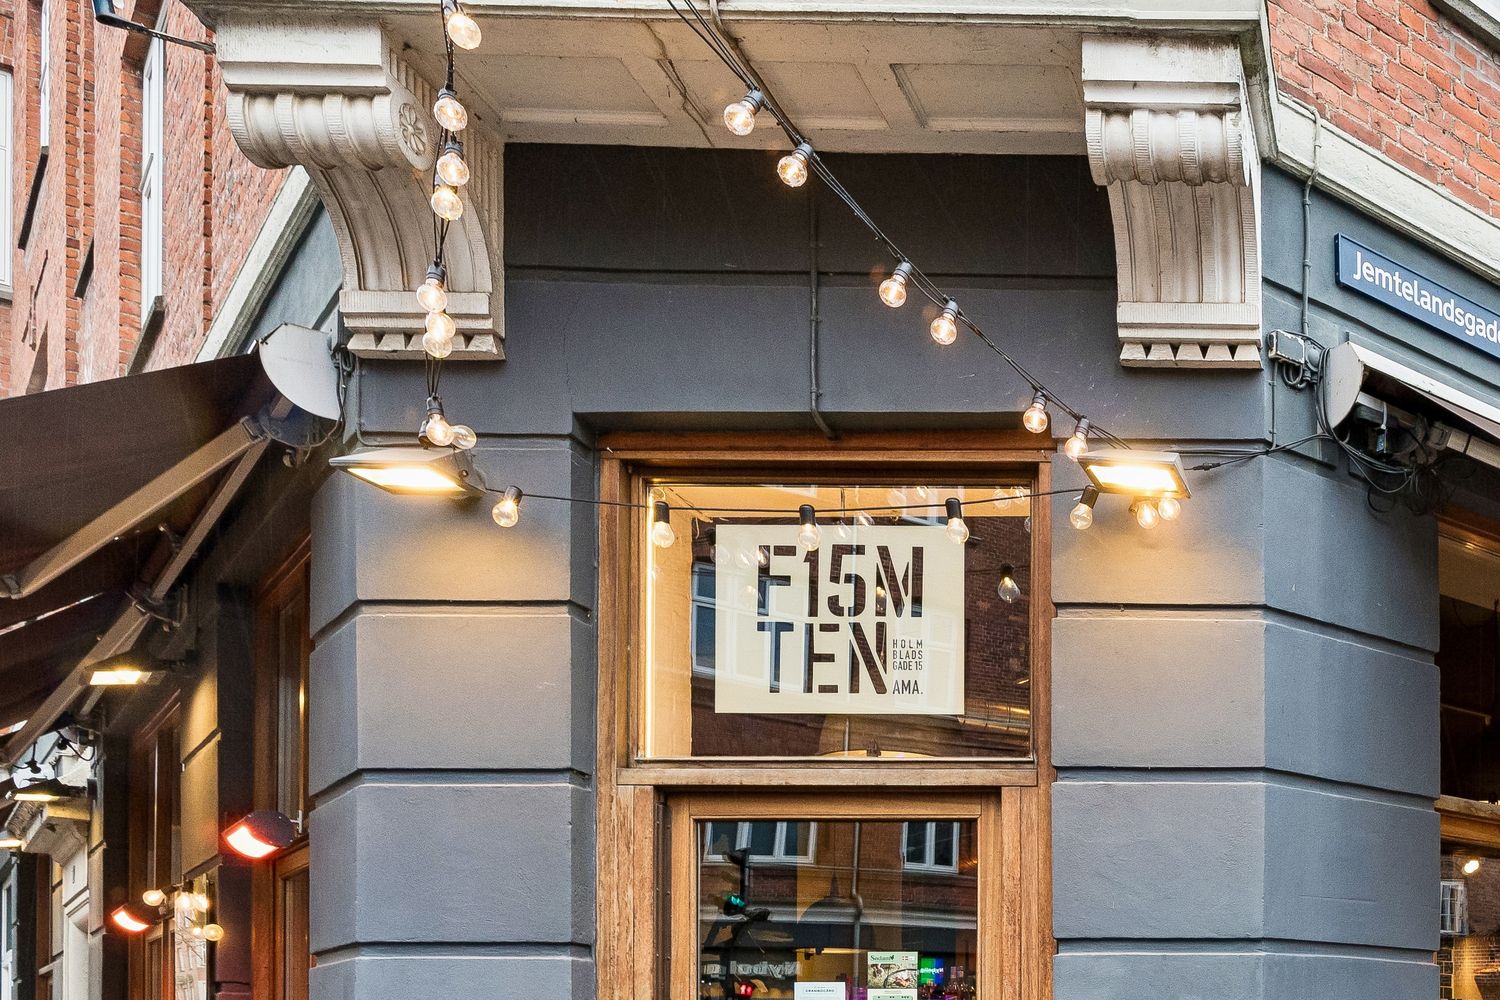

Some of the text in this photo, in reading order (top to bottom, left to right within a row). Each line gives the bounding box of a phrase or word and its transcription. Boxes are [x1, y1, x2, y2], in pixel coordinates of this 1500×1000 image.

[757, 544, 923, 618] F15M
[892, 639, 922, 649] HOLM
[757, 622, 887, 694] TEN
[892, 650, 923, 660] BLADS
[892, 660, 923, 670] GADE 15
[892, 679, 923, 695] AMA.
